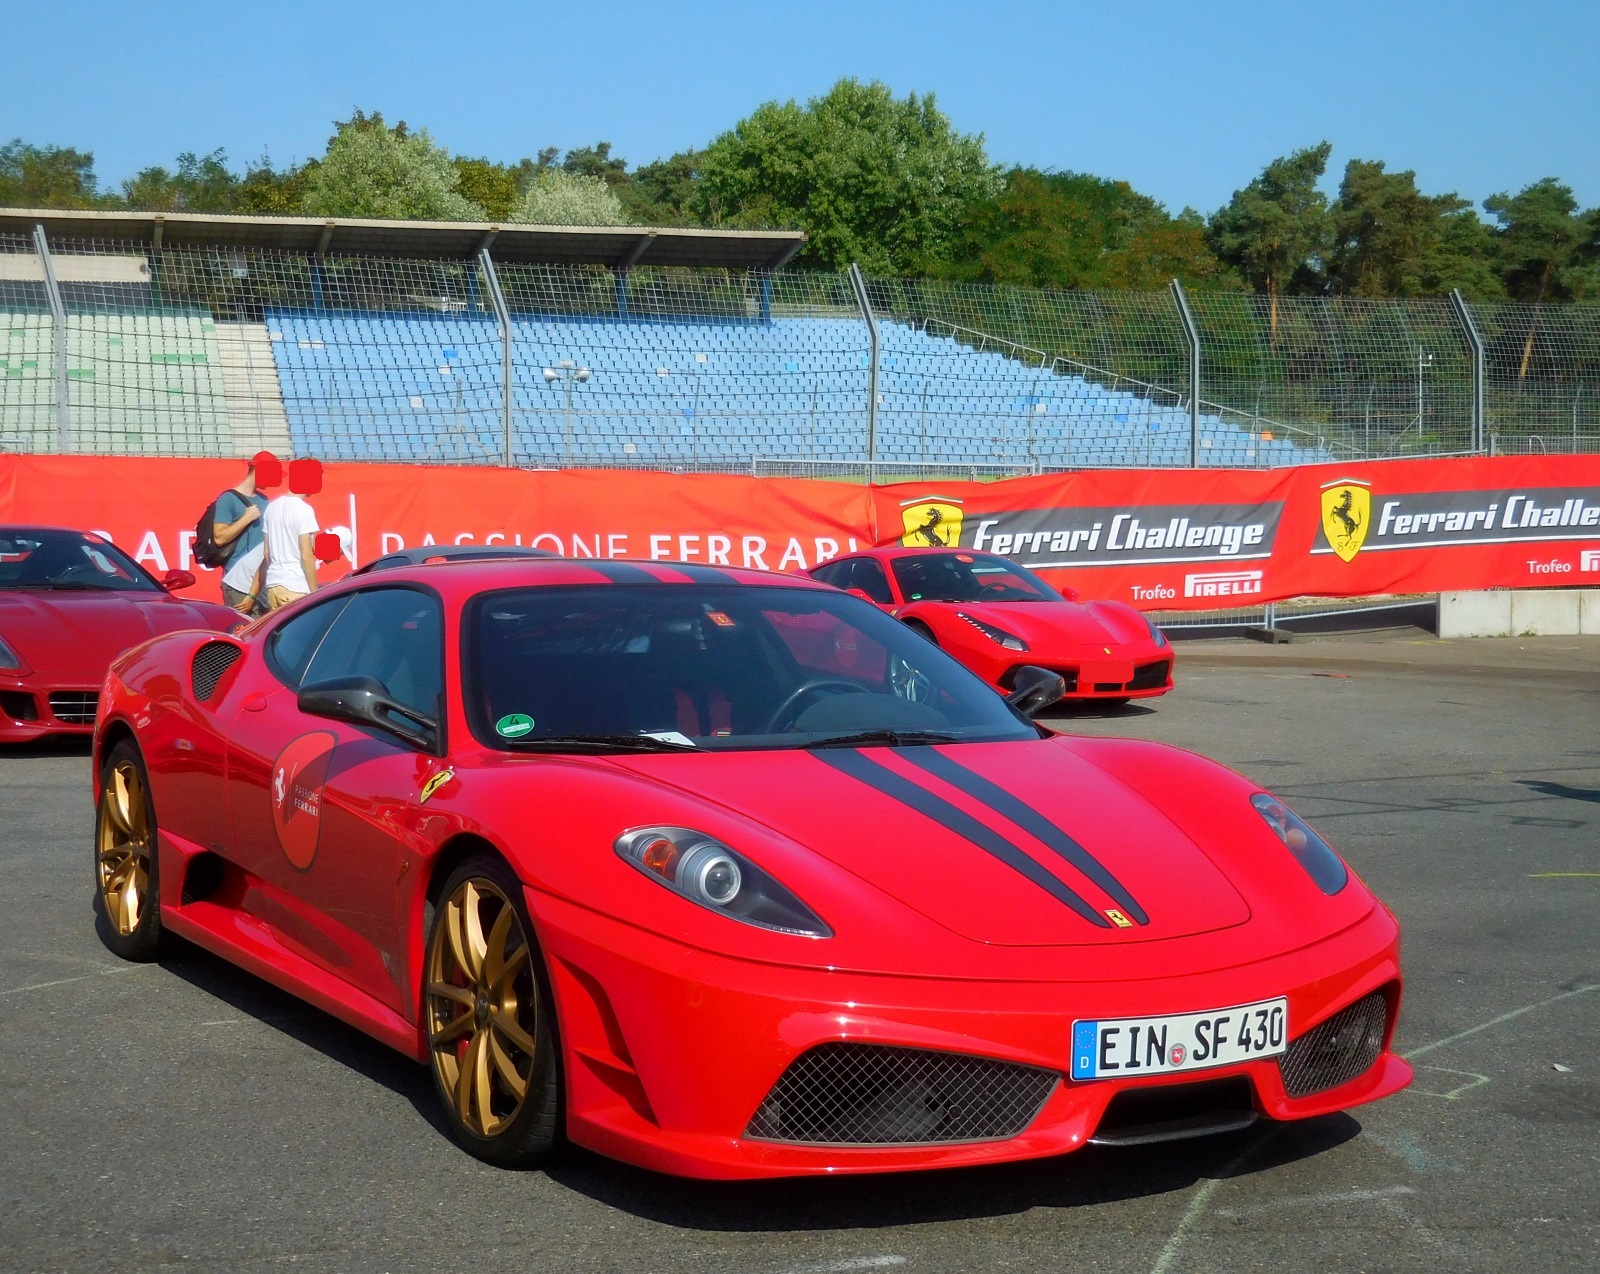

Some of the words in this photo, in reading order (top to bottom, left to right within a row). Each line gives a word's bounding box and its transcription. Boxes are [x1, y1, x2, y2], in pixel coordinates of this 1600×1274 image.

[1377, 502, 1498, 536] Ferrari
[1501, 496, 1600, 529] Challe
[972, 520, 1102, 555] Ferrari
[1105, 514, 1264, 554] Challenge
[1526, 559, 1572, 574] Trofeo
[1131, 585, 1175, 600] Trofeo
[1184, 570, 1263, 598] PIRELLI
[294, 797, 319, 817] FERRARI
[1099, 1024, 1168, 1070] EIN
[1192, 1016, 1231, 1061] SF
[1237, 1006, 1284, 1053] 430
[1080, 1056, 1090, 1069] D
